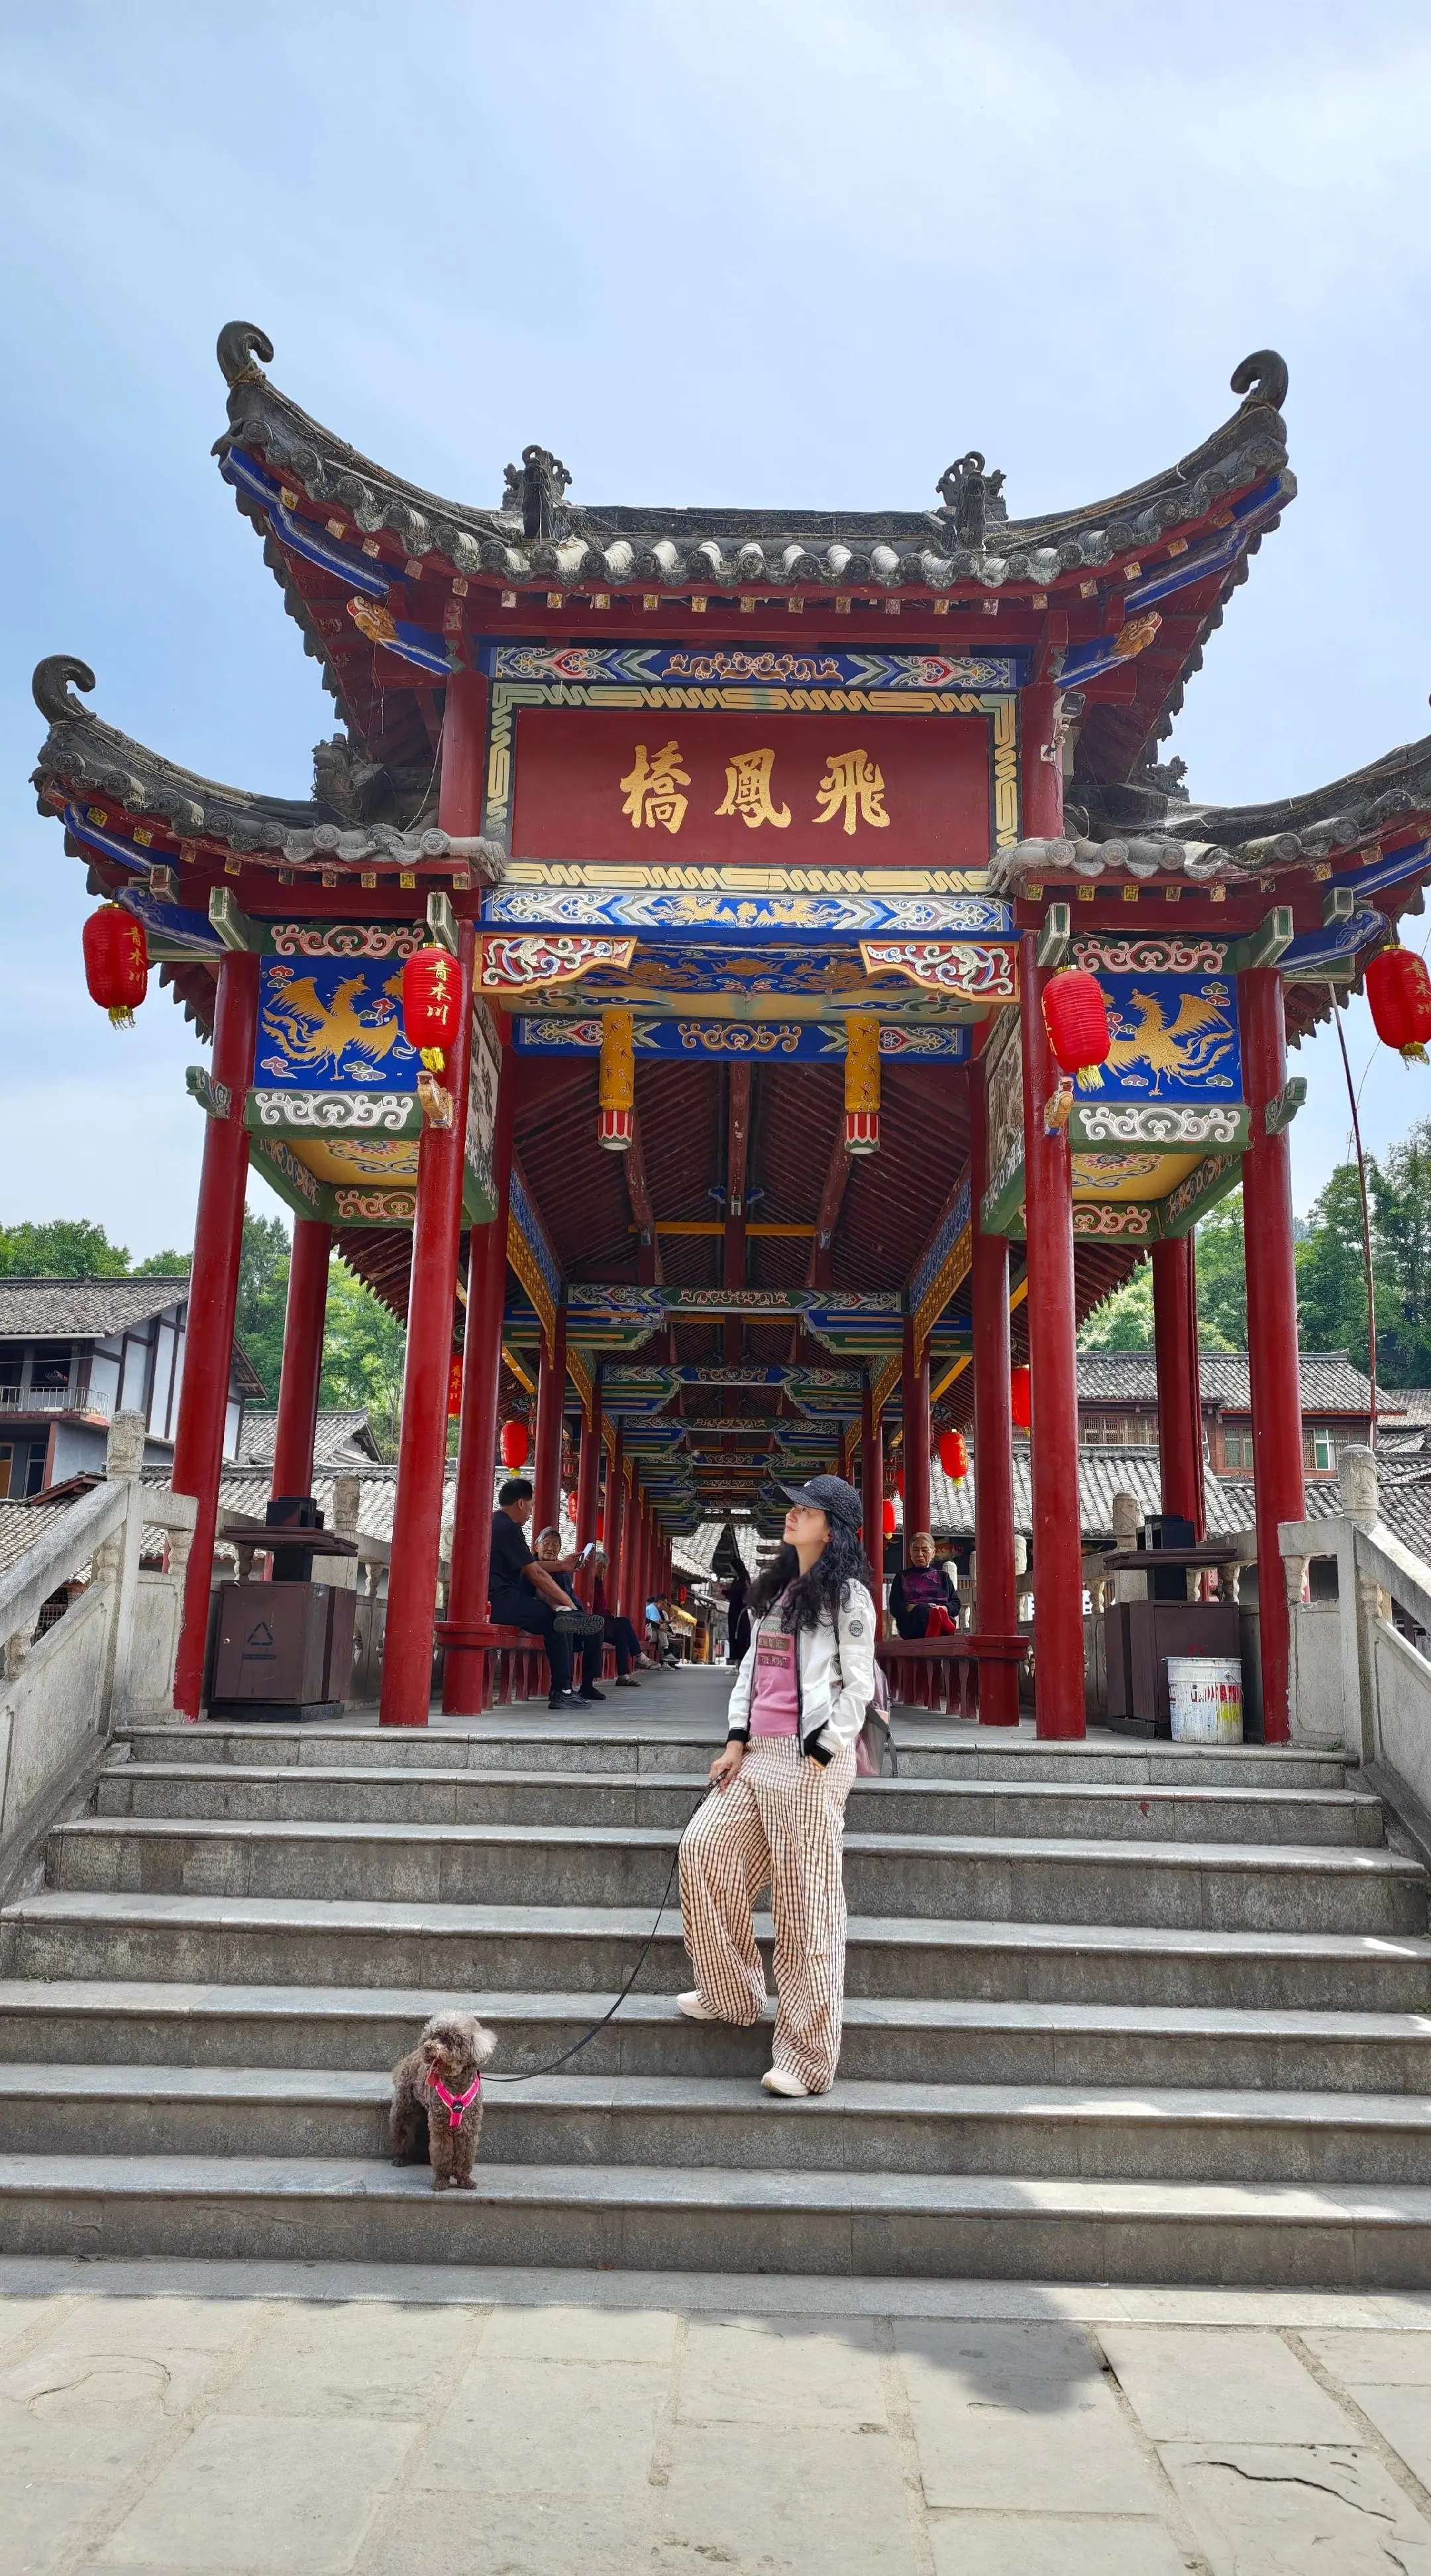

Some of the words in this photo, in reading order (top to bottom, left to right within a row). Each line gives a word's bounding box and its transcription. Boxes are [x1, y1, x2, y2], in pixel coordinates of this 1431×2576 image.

[122, 926, 146, 991] 青木川
[425, 958, 452, 1026] 青木川
[450, 1364, 462, 1403] 青木川
